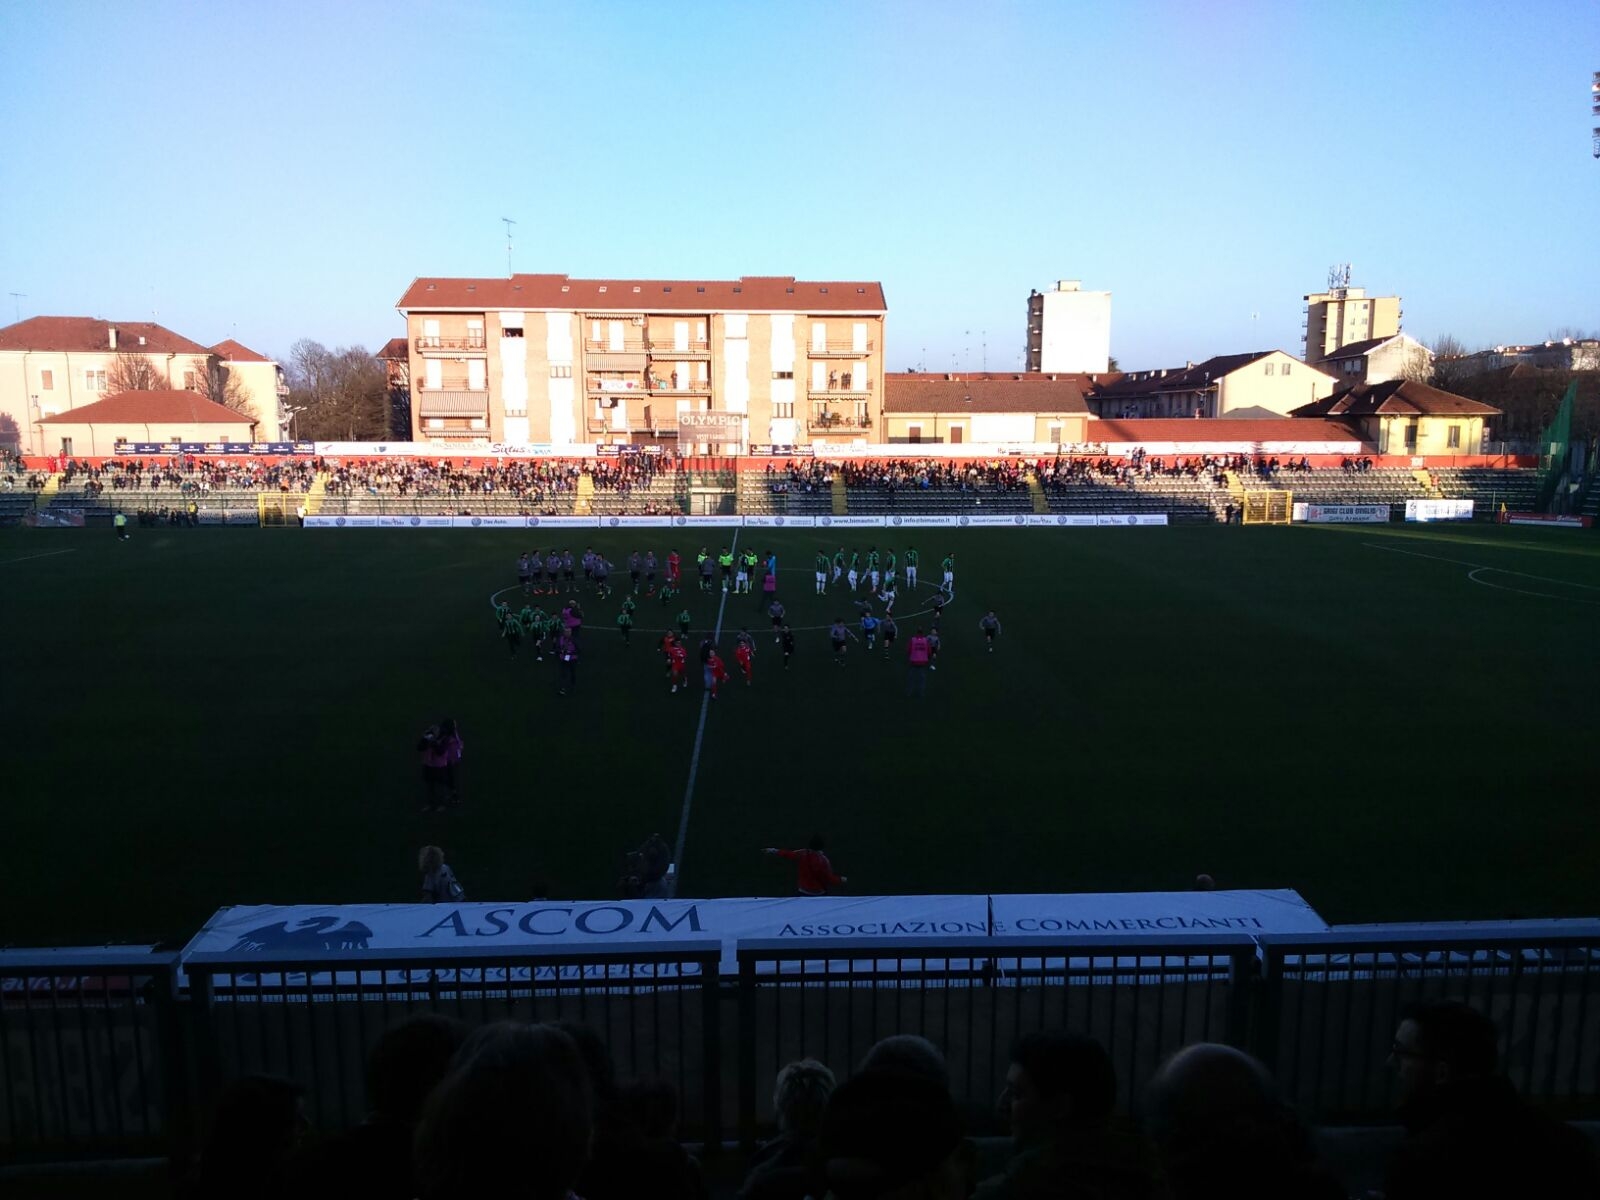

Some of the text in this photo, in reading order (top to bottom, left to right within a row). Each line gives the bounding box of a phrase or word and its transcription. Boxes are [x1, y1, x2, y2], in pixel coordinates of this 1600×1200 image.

[490, 443, 526, 456] Sixtus
[1339, 507, 1353, 515] CLUB
[414, 904, 704, 938] ASCOM
